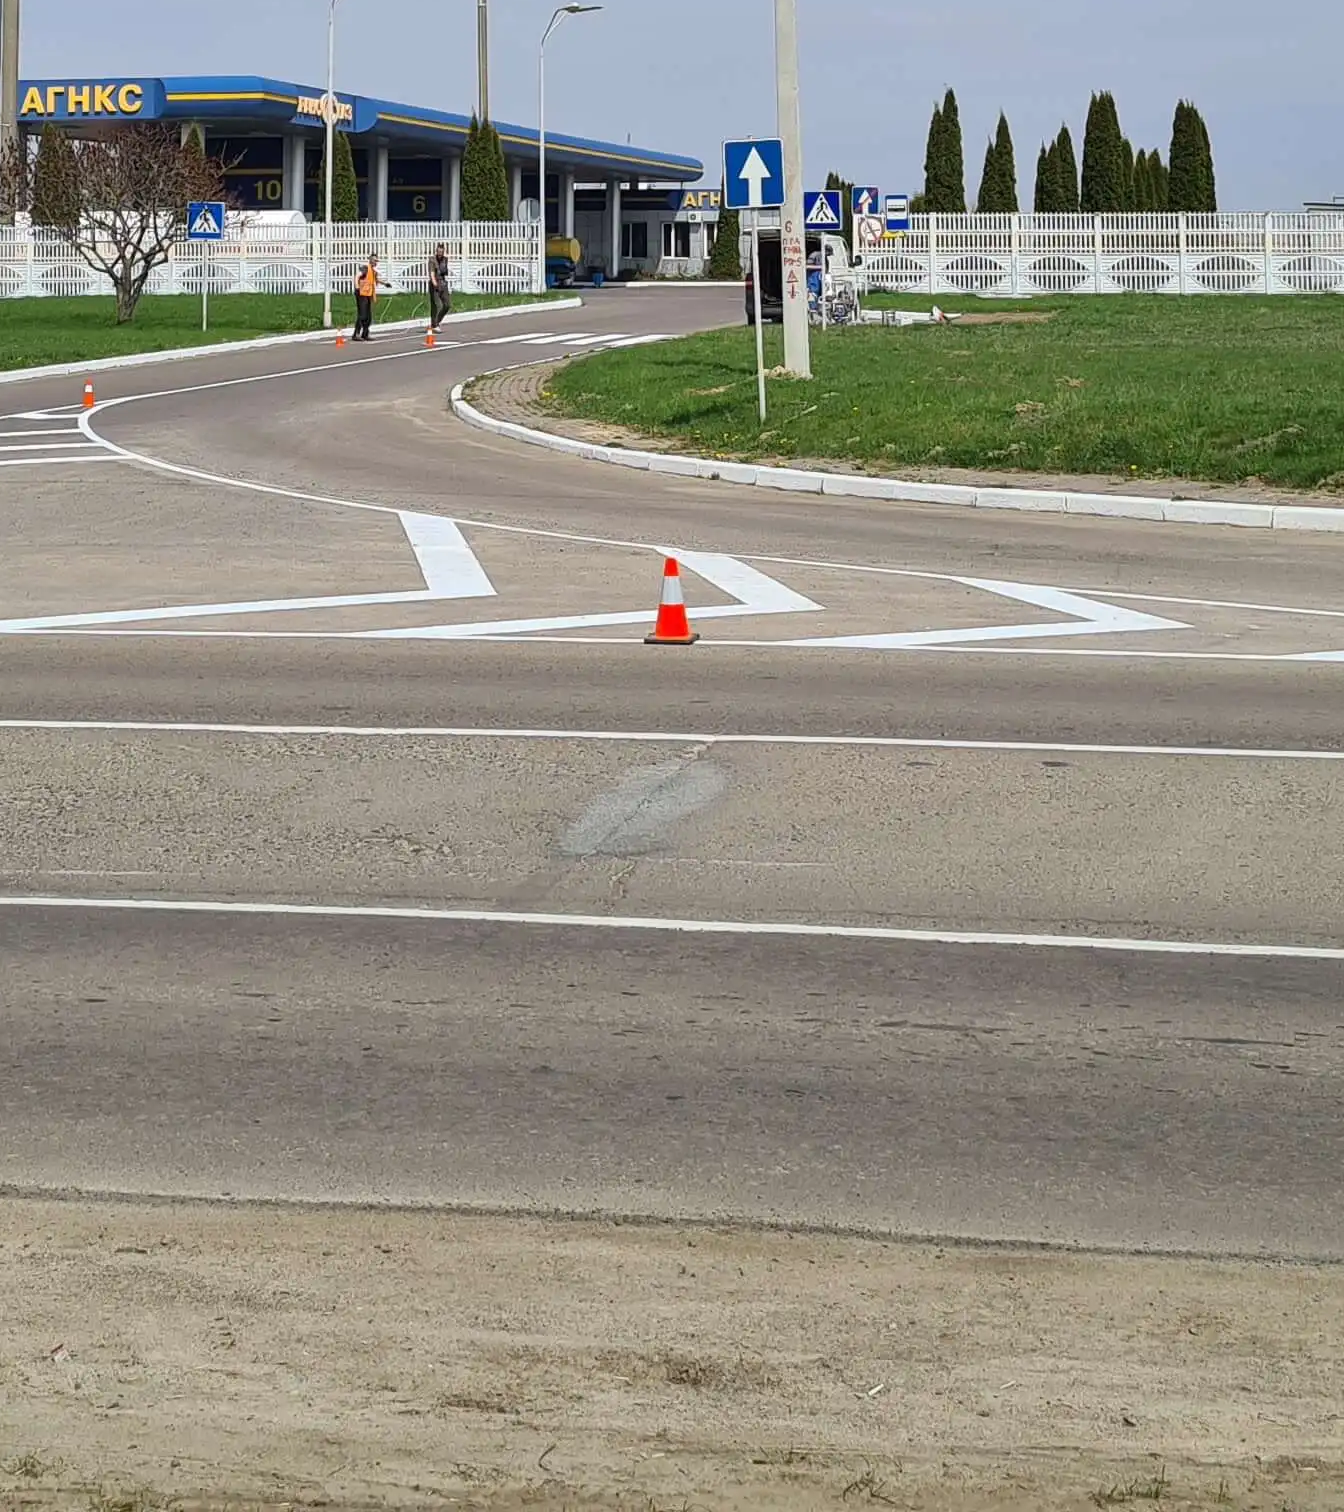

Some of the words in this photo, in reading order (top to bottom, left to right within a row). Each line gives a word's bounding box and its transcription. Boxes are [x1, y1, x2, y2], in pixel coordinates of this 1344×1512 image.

[20, 84, 143, 115] АГНКС
[254, 180, 282, 201] 10
[683, 191, 721, 207] АГН
[412, 195, 426, 213] 6
